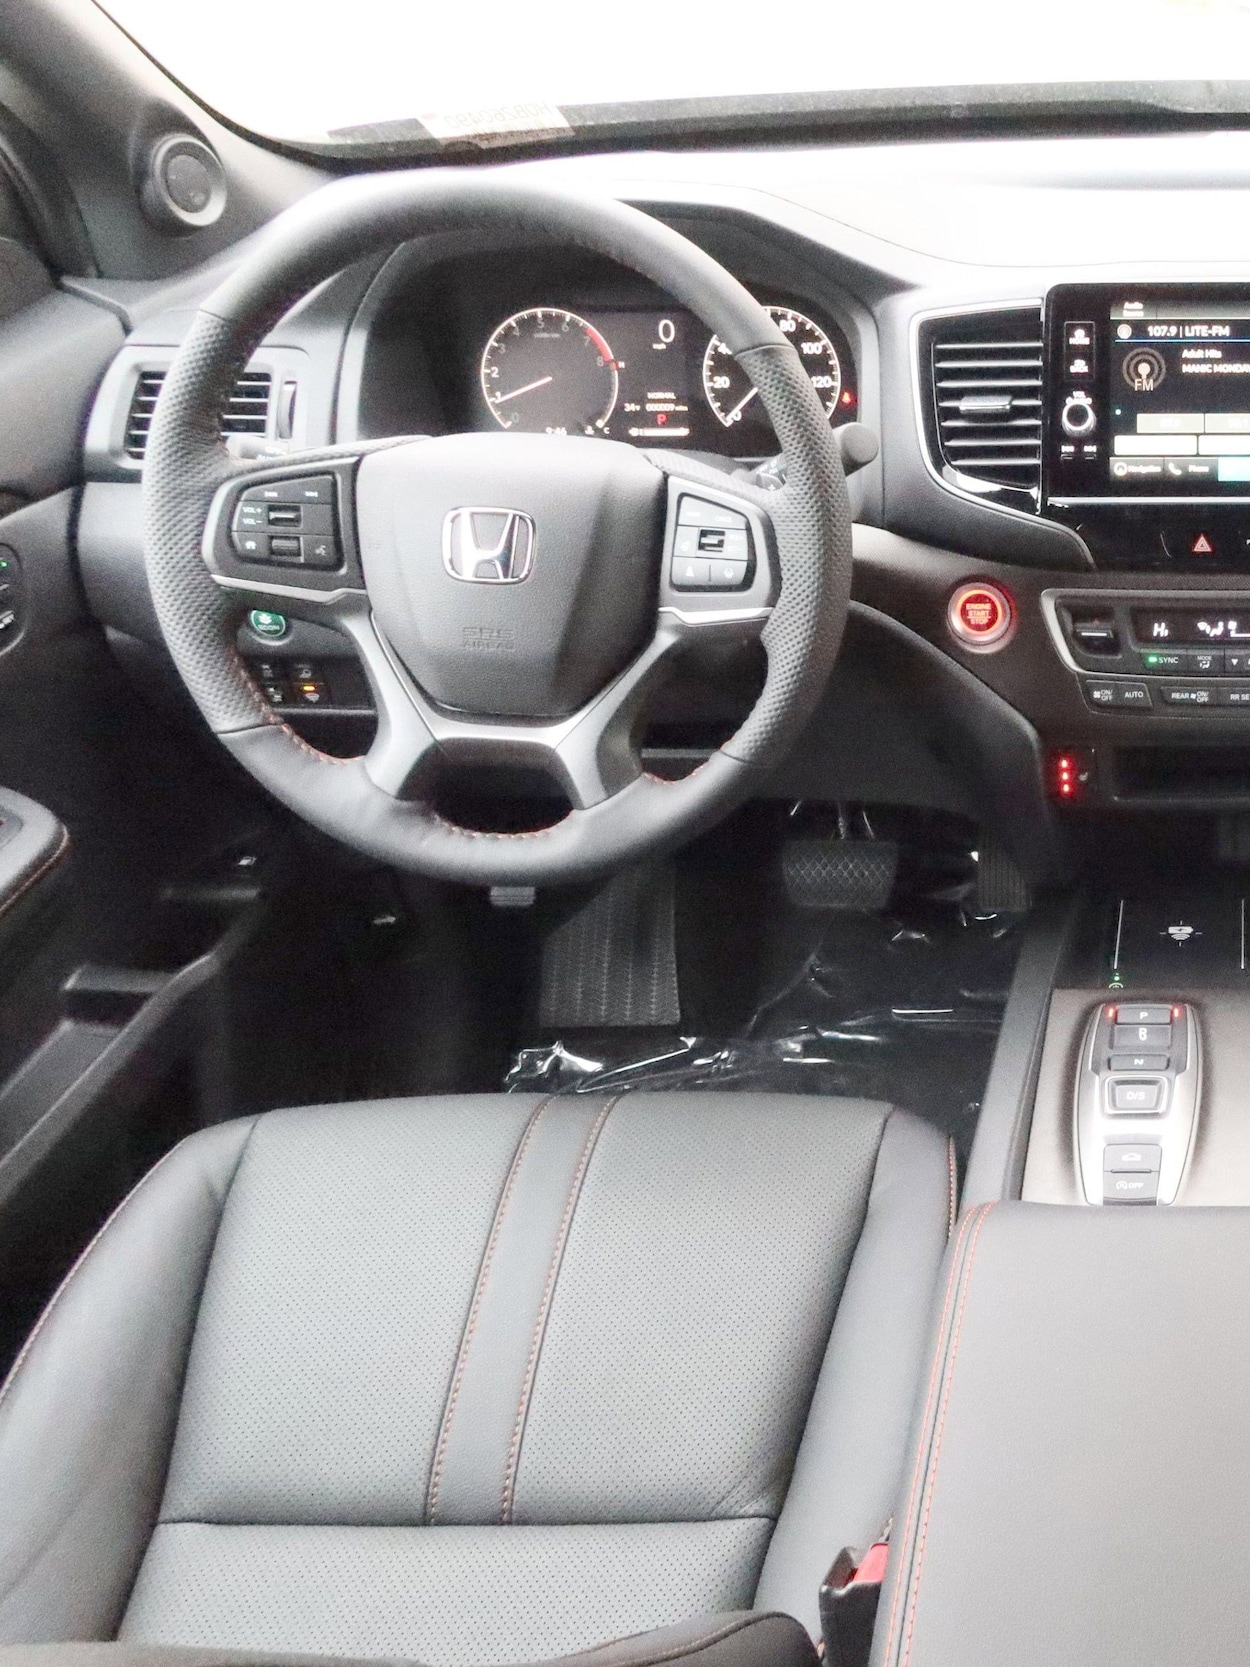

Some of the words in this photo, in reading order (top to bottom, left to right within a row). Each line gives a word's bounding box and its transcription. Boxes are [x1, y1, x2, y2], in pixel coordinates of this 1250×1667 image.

[561, 321, 570, 333] 6
[658, 319, 676, 343] 0
[779, 320, 796, 332] 80
[1148, 325, 1177, 337] 107.9
[1185, 325, 1230, 337] LITE-FM
[499, 343, 506, 354] 3
[801, 344, 823, 355] 100
[597, 355, 605, 367] 8
[490, 367, 500, 378] 2
[1182, 364, 1212, 374] MANIC
[713, 376, 730, 389] 20
[811, 376, 832, 388] 120
[1134, 378, 1154, 391] FM
[656, 413, 668, 426] P
[1158, 657, 1179, 665] SYNC
[1124, 691, 1144, 699] AUTO
[1171, 692, 1190, 700] REAR
[1230, 693, 1240, 701] RR
[1139, 1011, 1149, 1020] P
[1126, 1089, 1146, 1100] D/S
[1128, 1181, 1144, 1189] OFF
